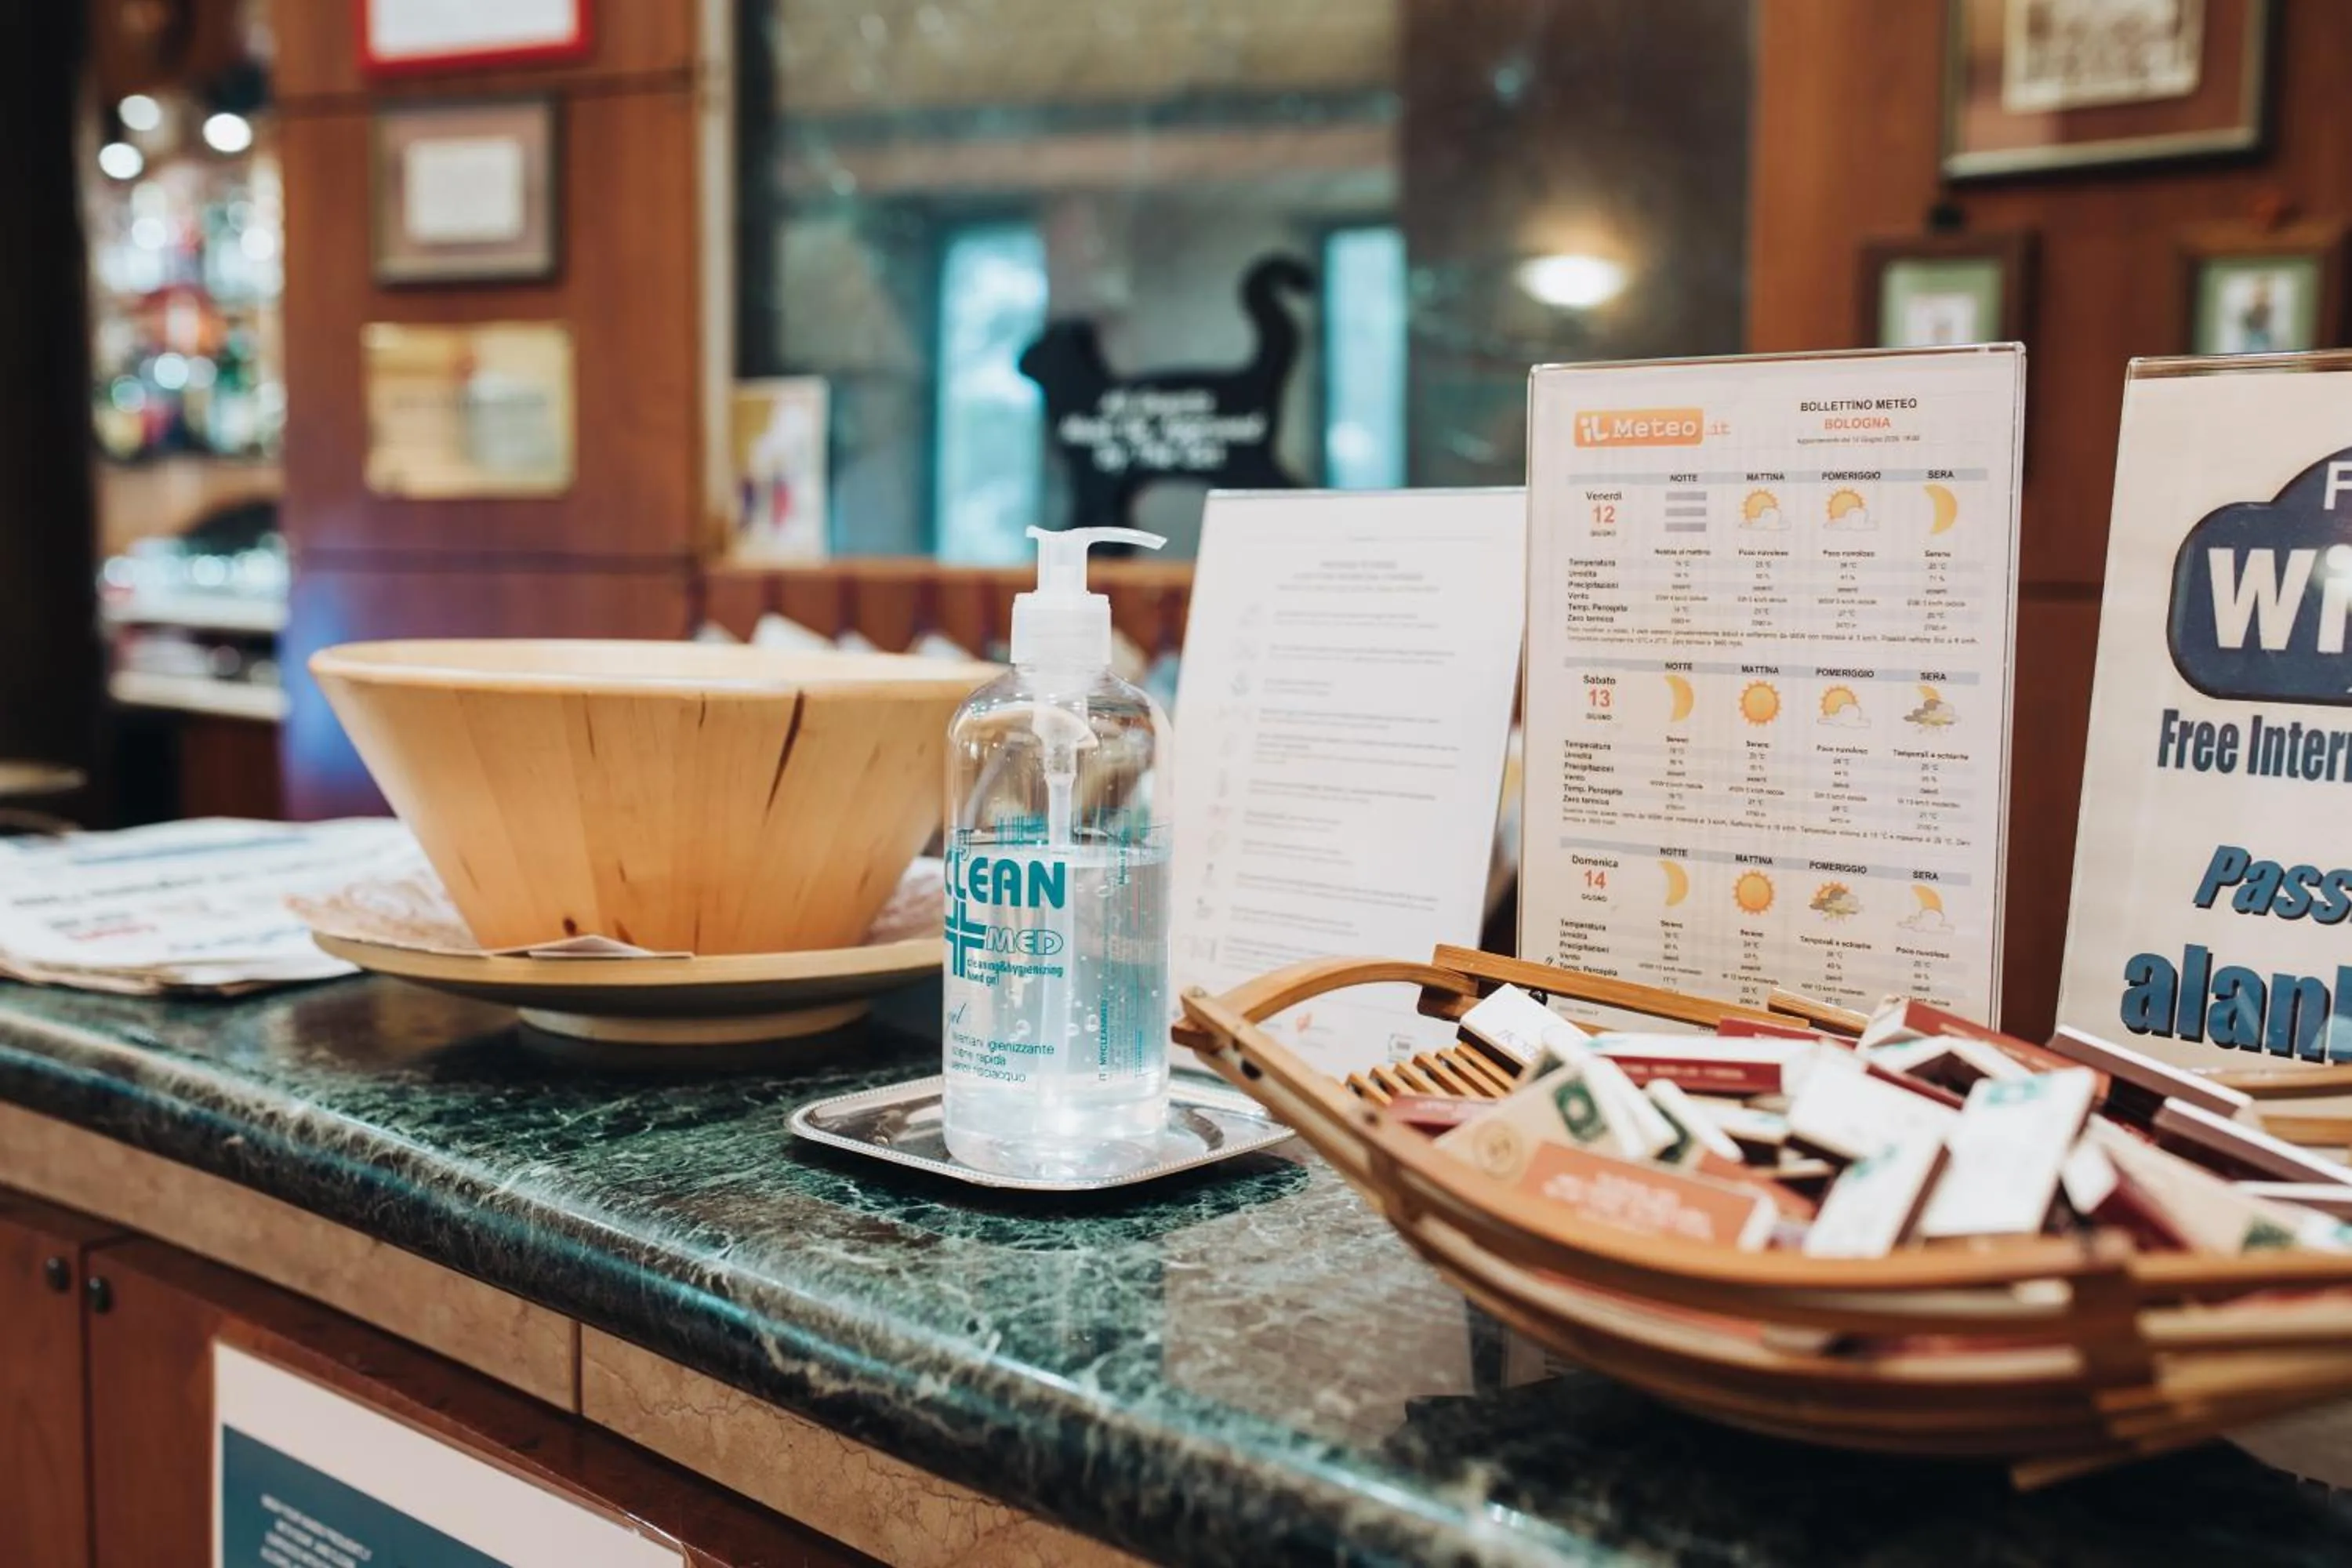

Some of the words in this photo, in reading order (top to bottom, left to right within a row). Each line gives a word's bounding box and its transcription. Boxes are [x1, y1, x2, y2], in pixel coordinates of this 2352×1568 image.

[1800, 399, 1872, 412] BOLLETTINO
[1875, 397, 1918, 410] METEO
[1613, 418, 1697, 439] Meteo
[1824, 417, 1891, 430] BOLOGNA
[1669, 474, 1699, 483] NOTTE
[1745, 473, 1785, 481] MATTINA
[1821, 471, 1881, 481] POMERIGGIO
[1928, 470, 1955, 480] SERA
[1592, 505, 1615, 524] 12
[1584, 674, 1616, 685] Sabato
[1664, 662, 1693, 671] NOTTE
[1741, 665, 1780, 675] MATTINA
[1815, 668, 1875, 678] POMERIGGIO
[1920, 672, 1947, 681] SERA
[1588, 688, 1611, 708] 13
[2158, 709, 2240, 775] Free
[1572, 855, 1619, 869] Domenica
[1660, 847, 1688, 857] NOTTE
[1735, 854, 1773, 866] MATTINA
[1809, 860, 1867, 874] POMERIGGIO
[1912, 870, 1939, 881] SERA
[1584, 869, 1607, 889] 14
[2193, 844, 2352, 925] Pass
[985, 926, 1064, 956] MED
